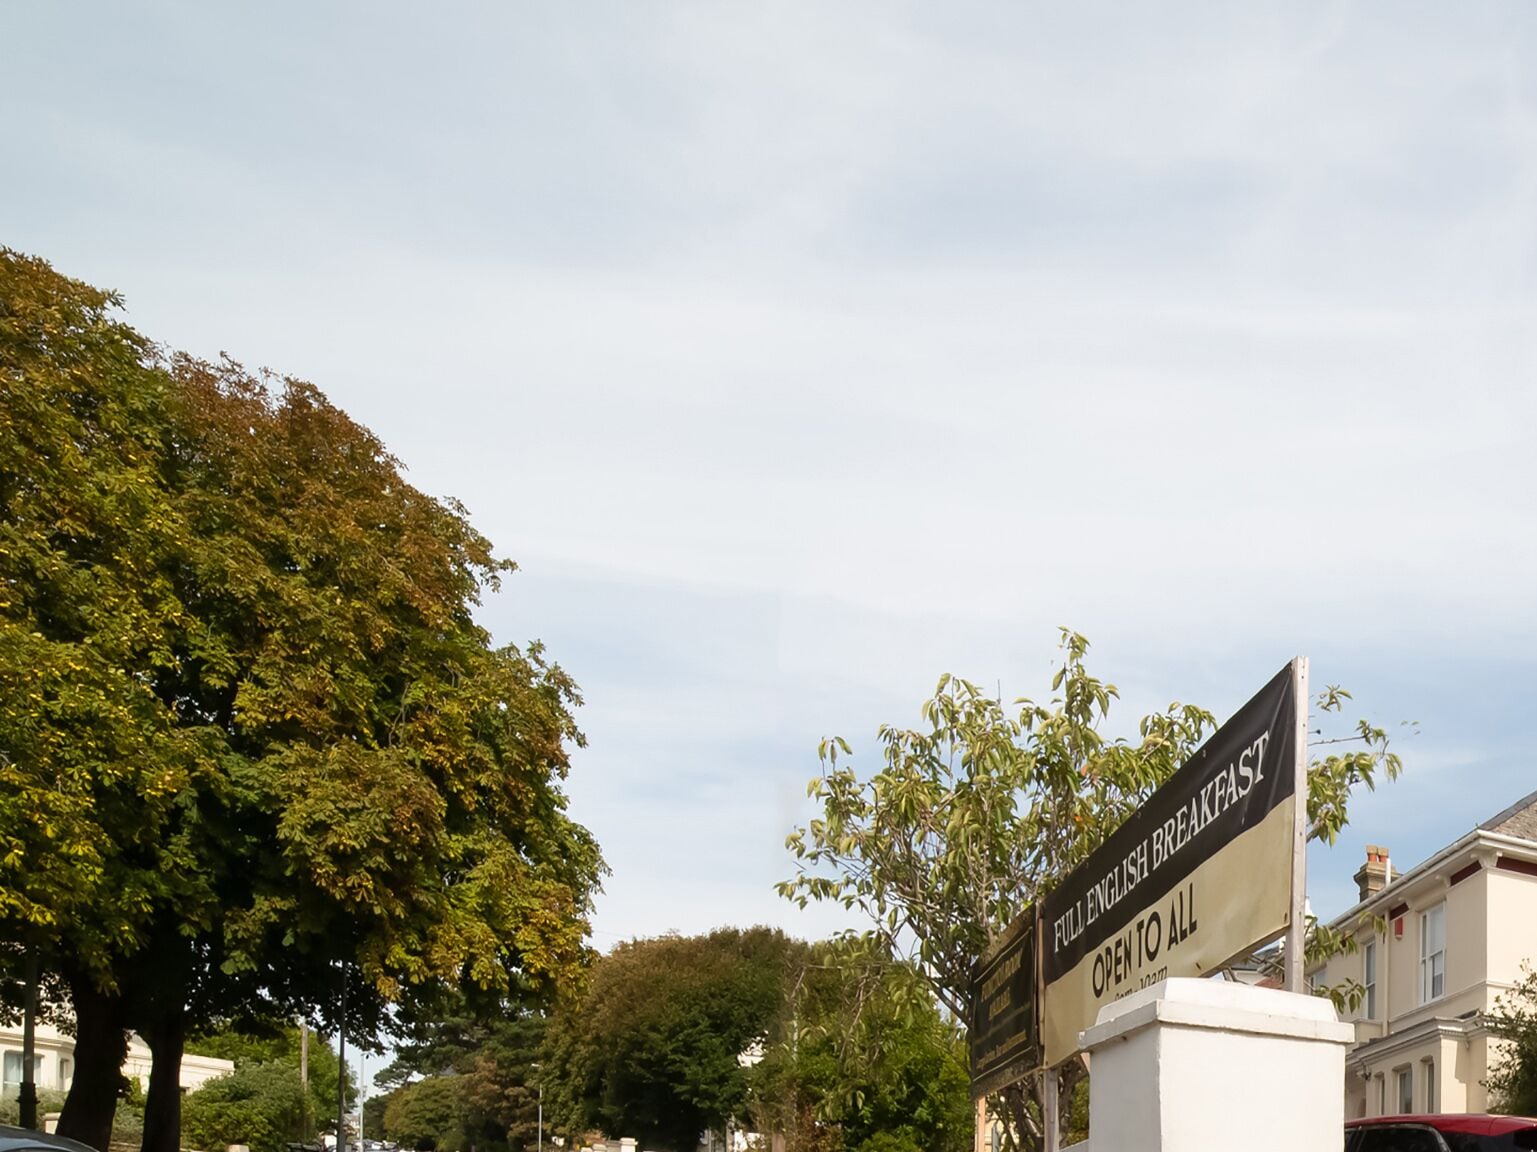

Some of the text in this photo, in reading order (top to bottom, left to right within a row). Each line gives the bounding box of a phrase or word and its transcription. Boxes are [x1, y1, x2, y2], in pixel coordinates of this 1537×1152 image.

[1054, 731, 1269, 953] FULL ENGLISH BREAKFAST
[1093, 929, 1132, 999] OPEN
[1136, 911, 1162, 968] TO
[1167, 882, 1198, 951] ALL
